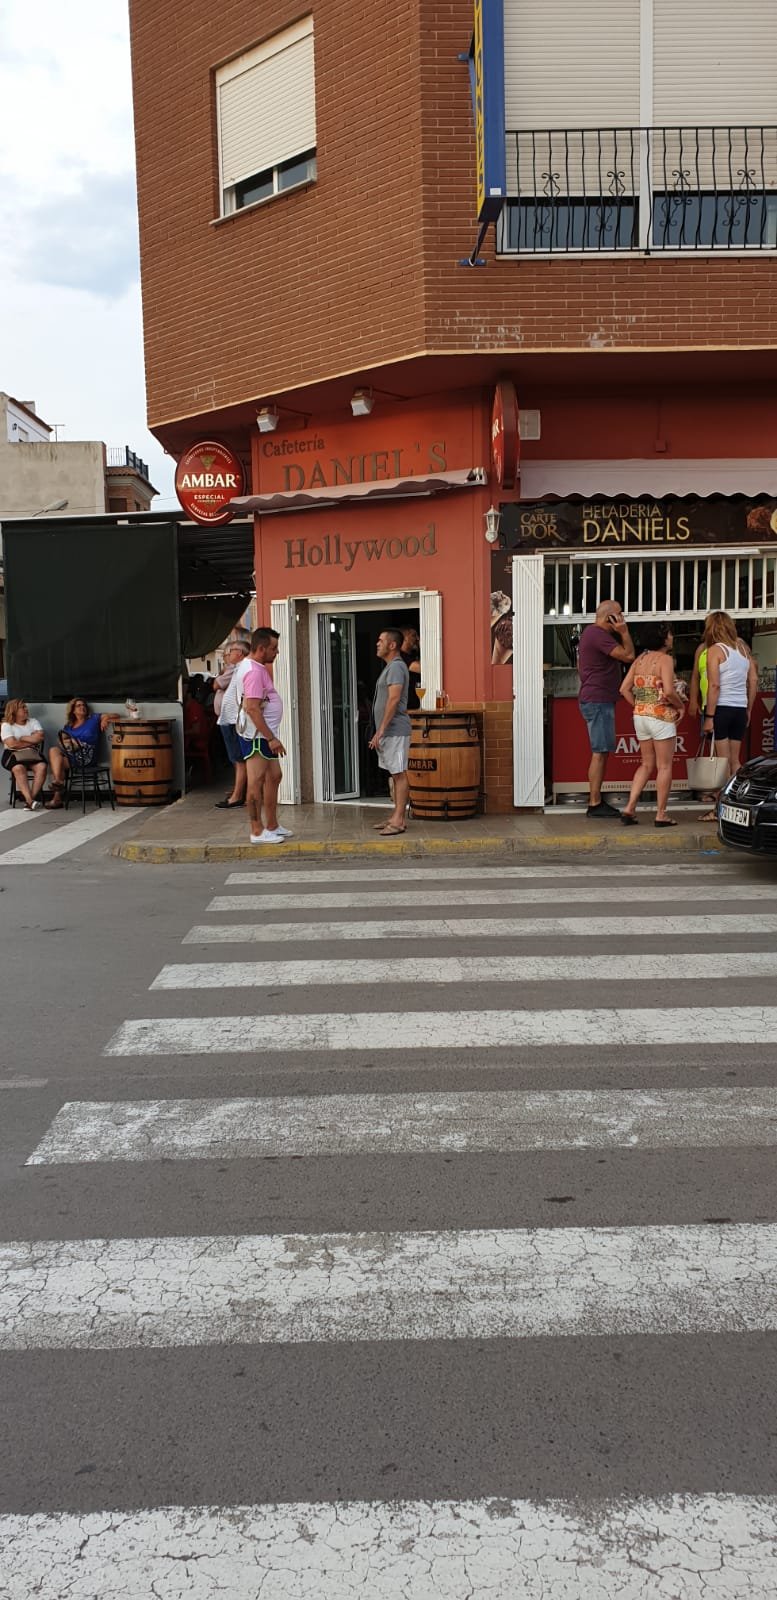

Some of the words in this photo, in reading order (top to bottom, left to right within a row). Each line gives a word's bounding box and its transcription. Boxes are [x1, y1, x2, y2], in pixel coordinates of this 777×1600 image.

[262, 434, 325, 458] Cafetería
[182, 473, 238, 488] AMBAR
[520, 512, 558, 525] CARTE
[583, 517, 690, 543] DANIELS
[284, 522, 438, 572] Hollywood
[614, 735, 687, 754] AMR
[126, 759, 153, 768] AMBAR
